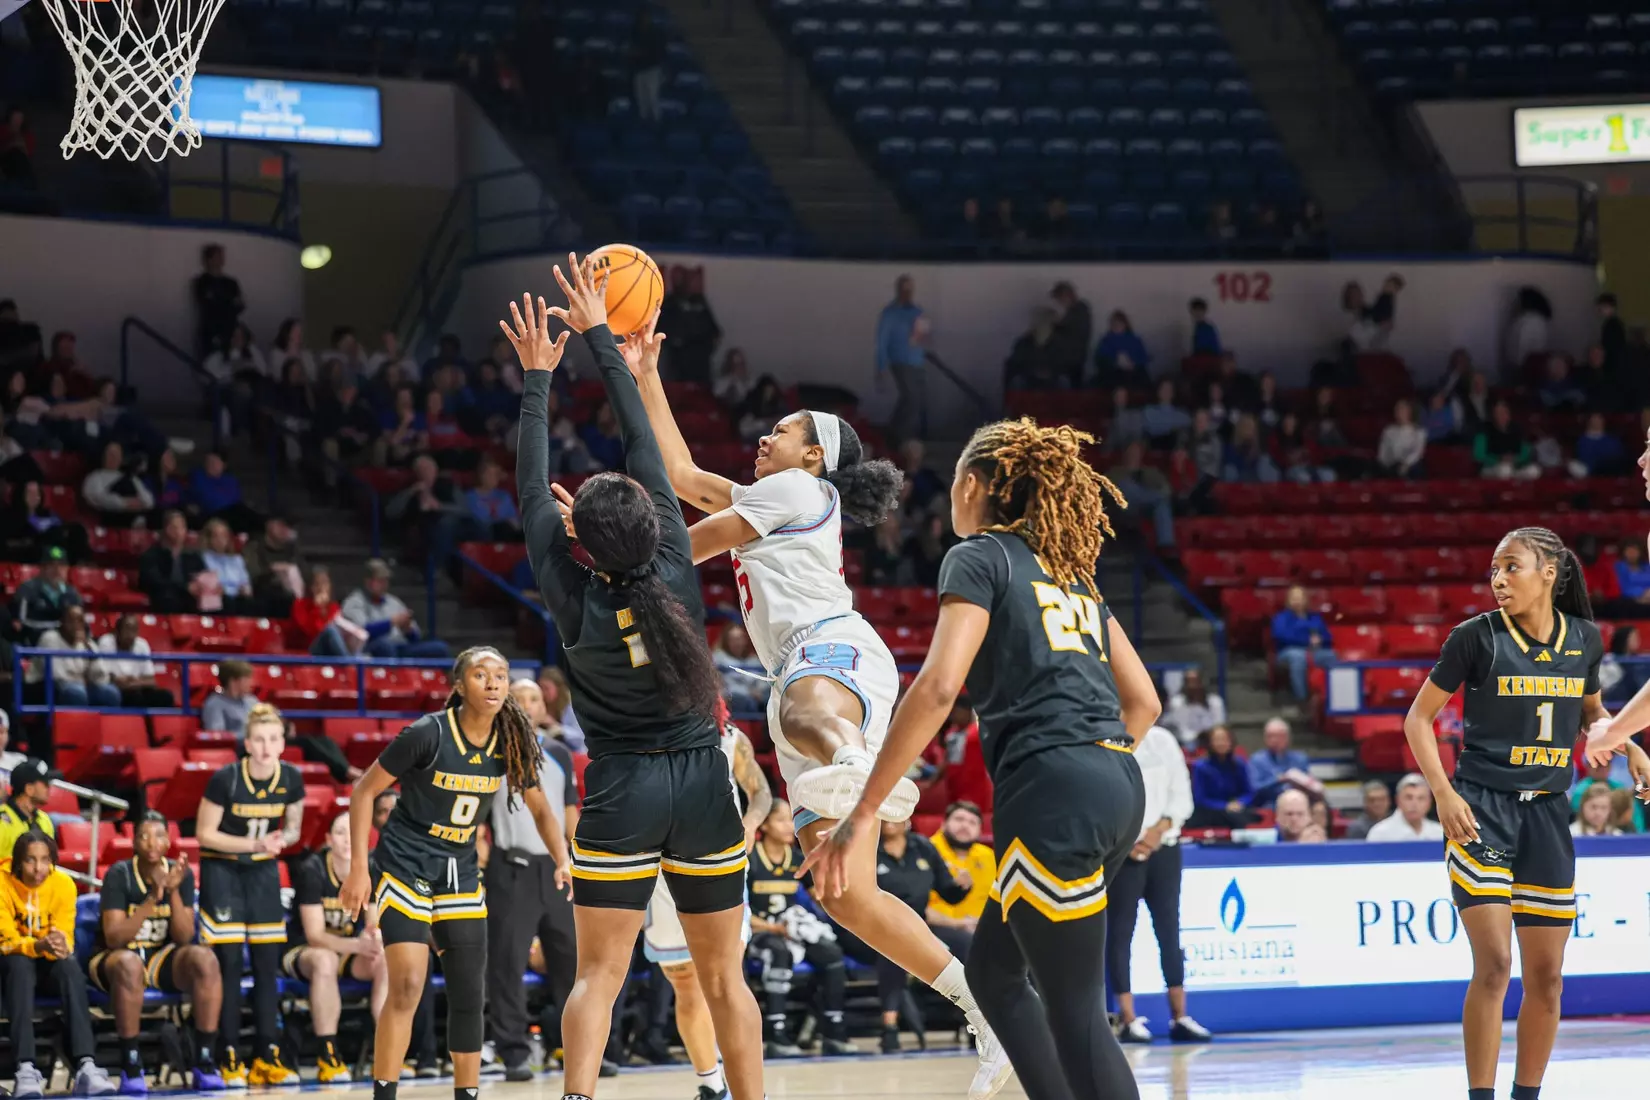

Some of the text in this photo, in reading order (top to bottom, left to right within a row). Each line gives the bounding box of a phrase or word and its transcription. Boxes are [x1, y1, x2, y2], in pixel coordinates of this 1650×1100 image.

[1527, 120, 1601, 148] Super
[1606, 113, 1629, 153] 1
[1214, 271, 1273, 303] 102
[1030, 581, 1108, 662] 24
[1536, 702, 1554, 741] 1
[1510, 745, 1571, 767] STATE
[450, 794, 480, 825] 0
[246, 818, 269, 839] 11
[768, 894, 787, 914] 3
[1183, 939, 1295, 962] ouisiana
